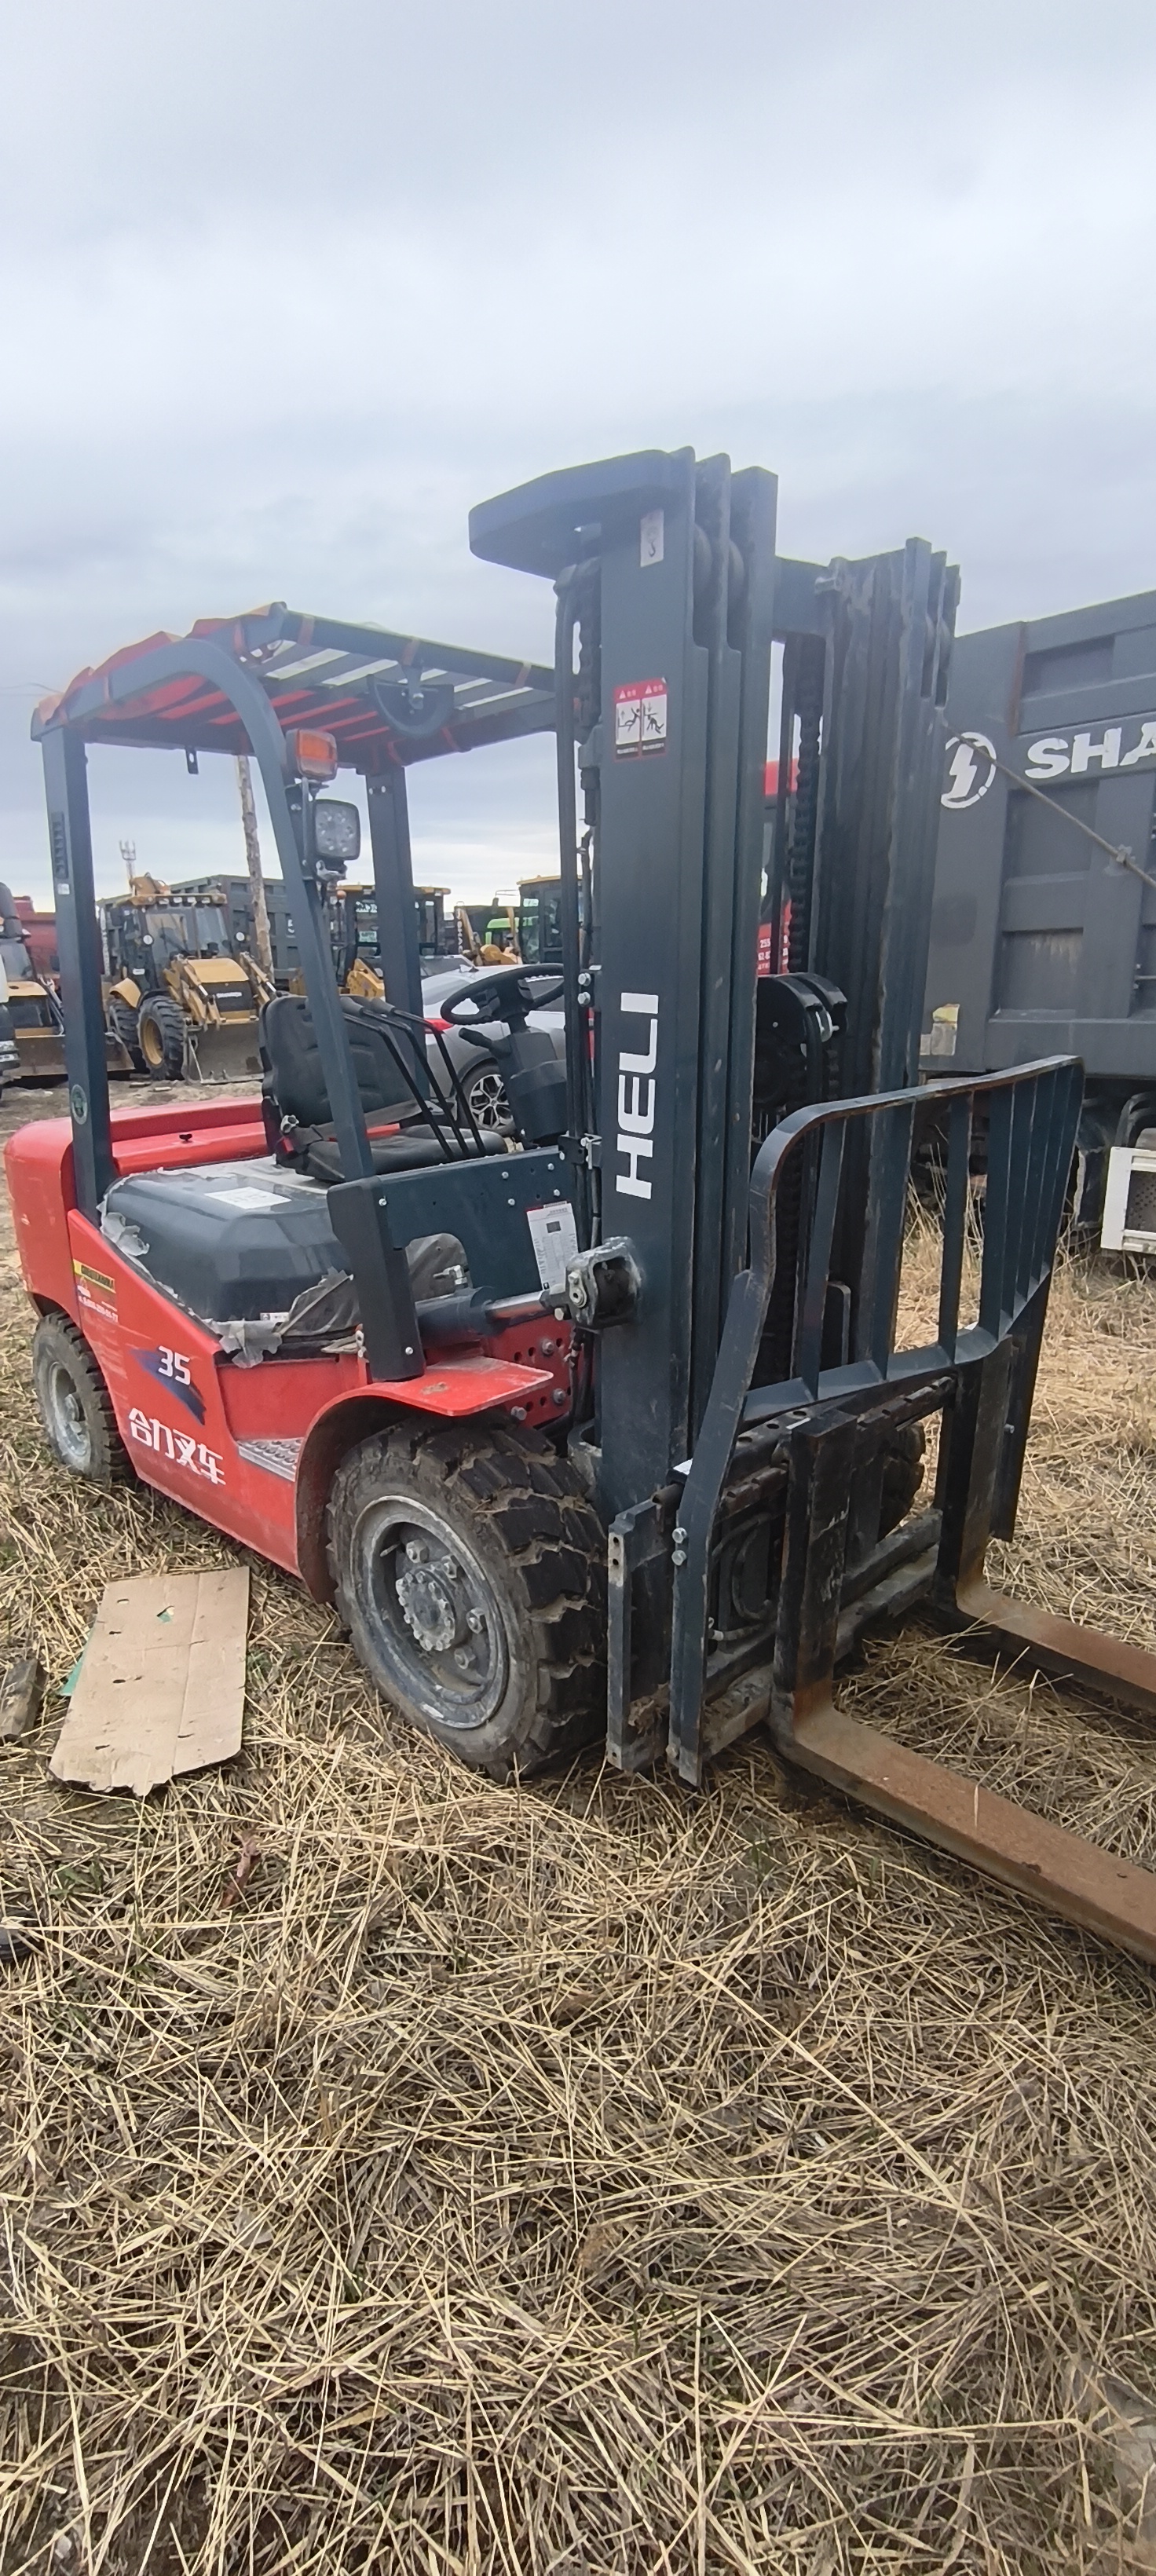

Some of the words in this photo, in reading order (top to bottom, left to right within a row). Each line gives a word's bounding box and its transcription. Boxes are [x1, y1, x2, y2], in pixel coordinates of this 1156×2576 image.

[616, 992, 659, 1199] HELI
[158, 1345, 191, 1385] 35
[128, 1407, 226, 1485] 合力叉车
